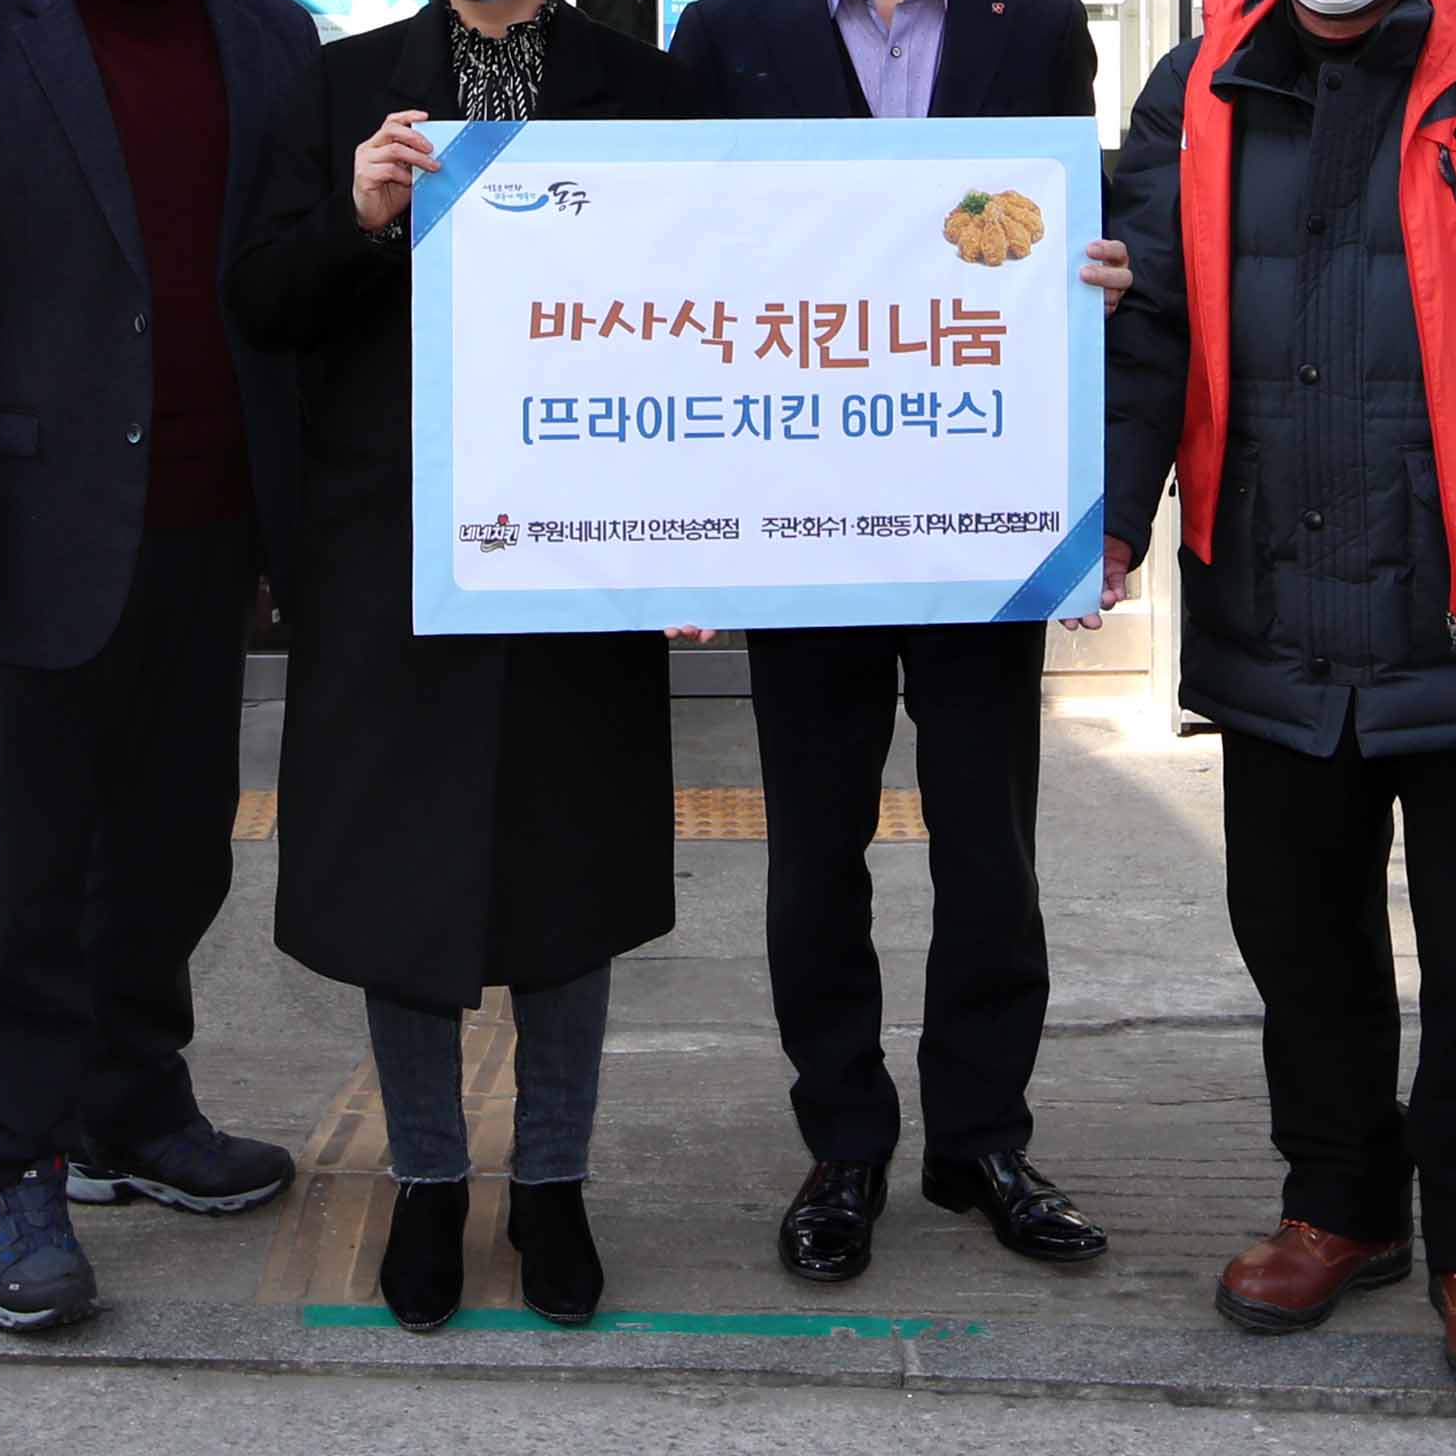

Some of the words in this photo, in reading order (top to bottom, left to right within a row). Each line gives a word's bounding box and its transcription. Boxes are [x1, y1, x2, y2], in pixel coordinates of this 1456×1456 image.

[547, 181, 591, 216] 동구
[529, 300, 738, 364] 바사삭
[753, 299, 870, 369] 치킨
[889, 298, 1007, 367] 나눔
[458, 522, 520, 546] 네네치킨
[648, 517, 740, 541] 인천송현점
